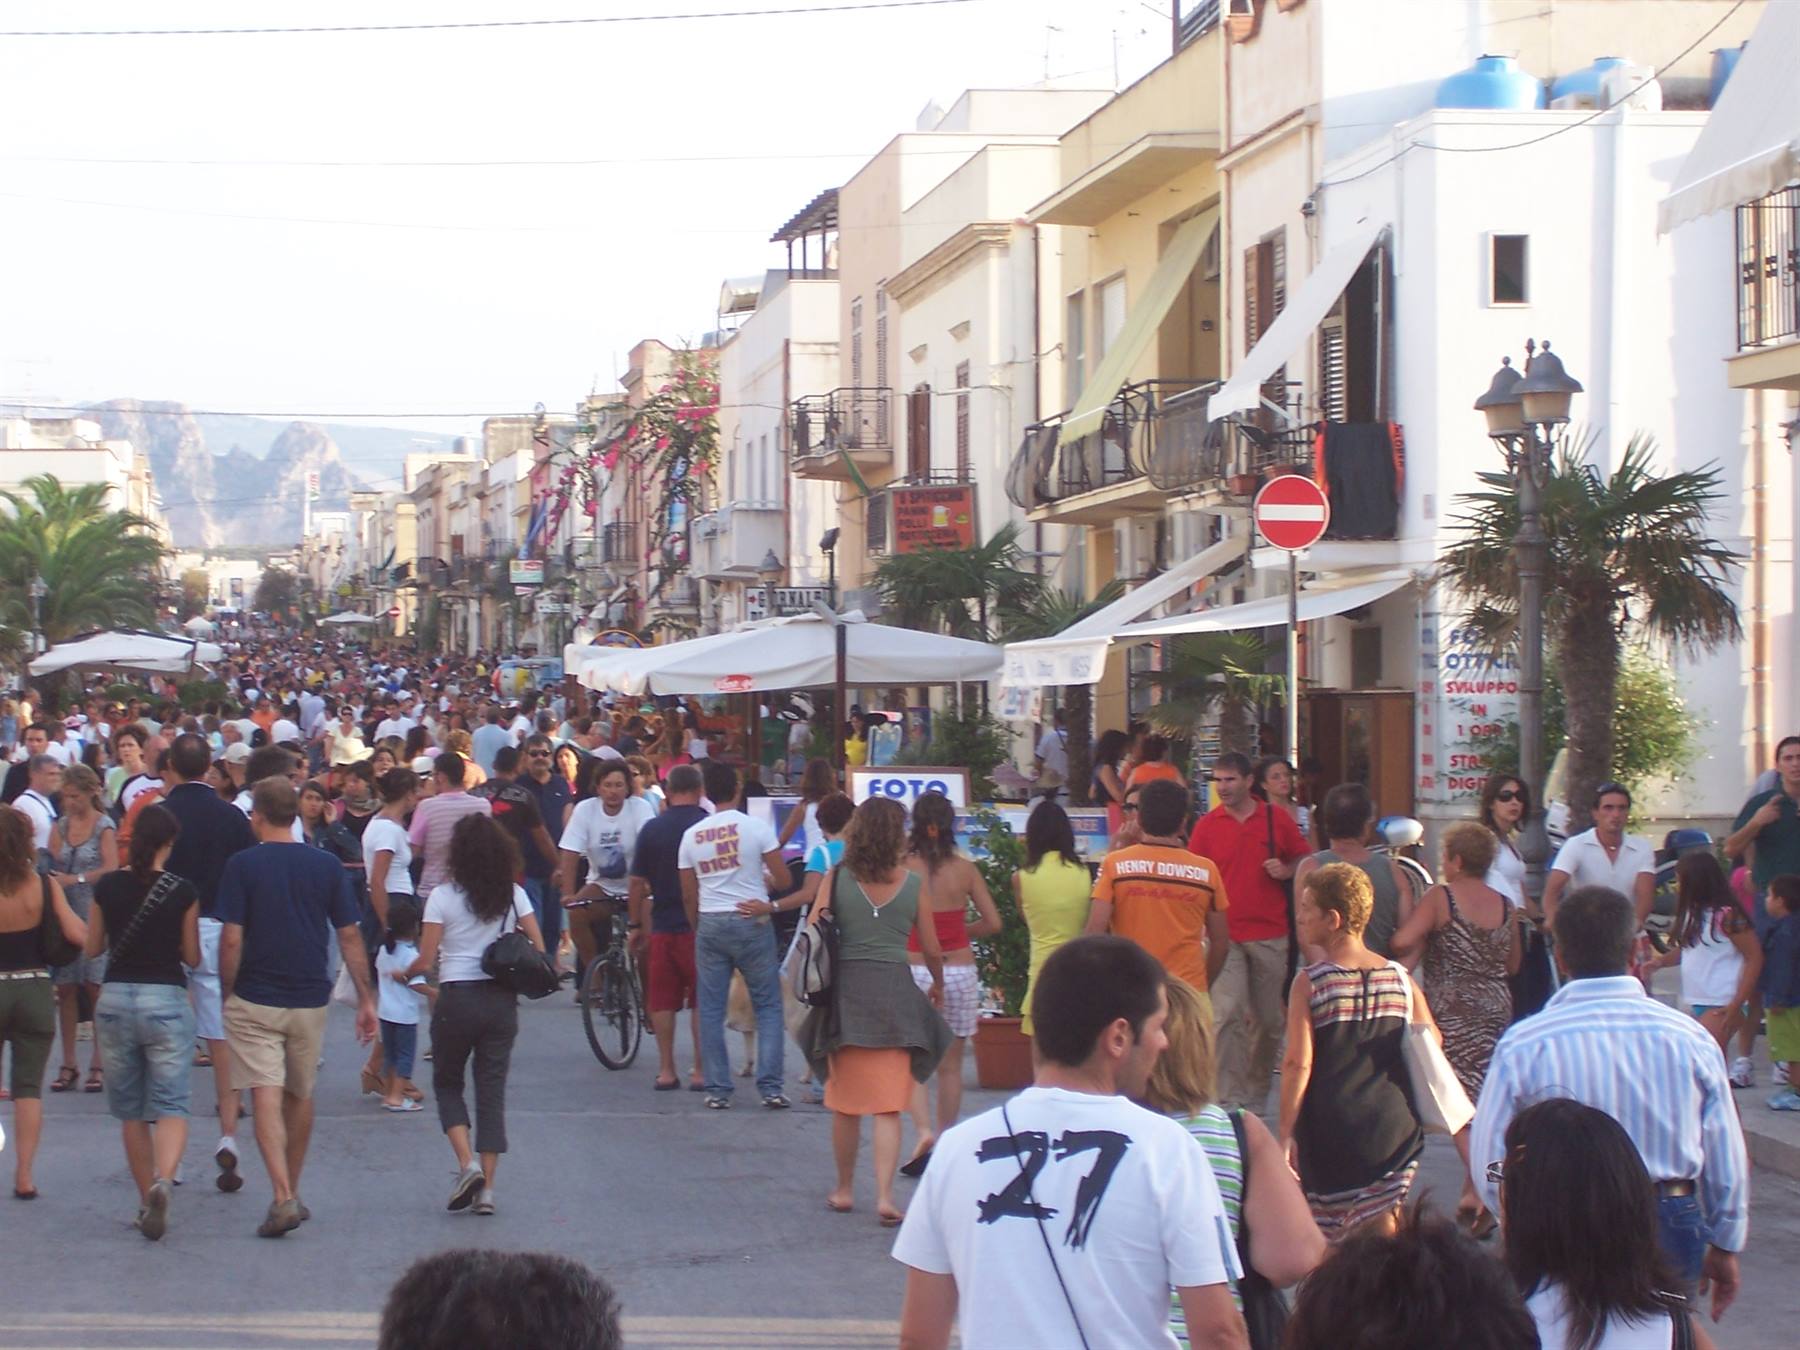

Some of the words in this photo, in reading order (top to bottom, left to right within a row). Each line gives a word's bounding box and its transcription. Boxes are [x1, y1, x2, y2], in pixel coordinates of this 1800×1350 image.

[1446, 681, 1517, 694] SVILUPPO
[1471, 704, 1487, 716] IN
[1457, 724, 1463, 736] 1
[868, 779, 948, 799] FOTO
[716, 839, 739, 855] MY
[1115, 860, 1155, 875] HENRY
[1157, 862, 1209, 882] DOWSON
[975, 1130, 1133, 1252] 27
